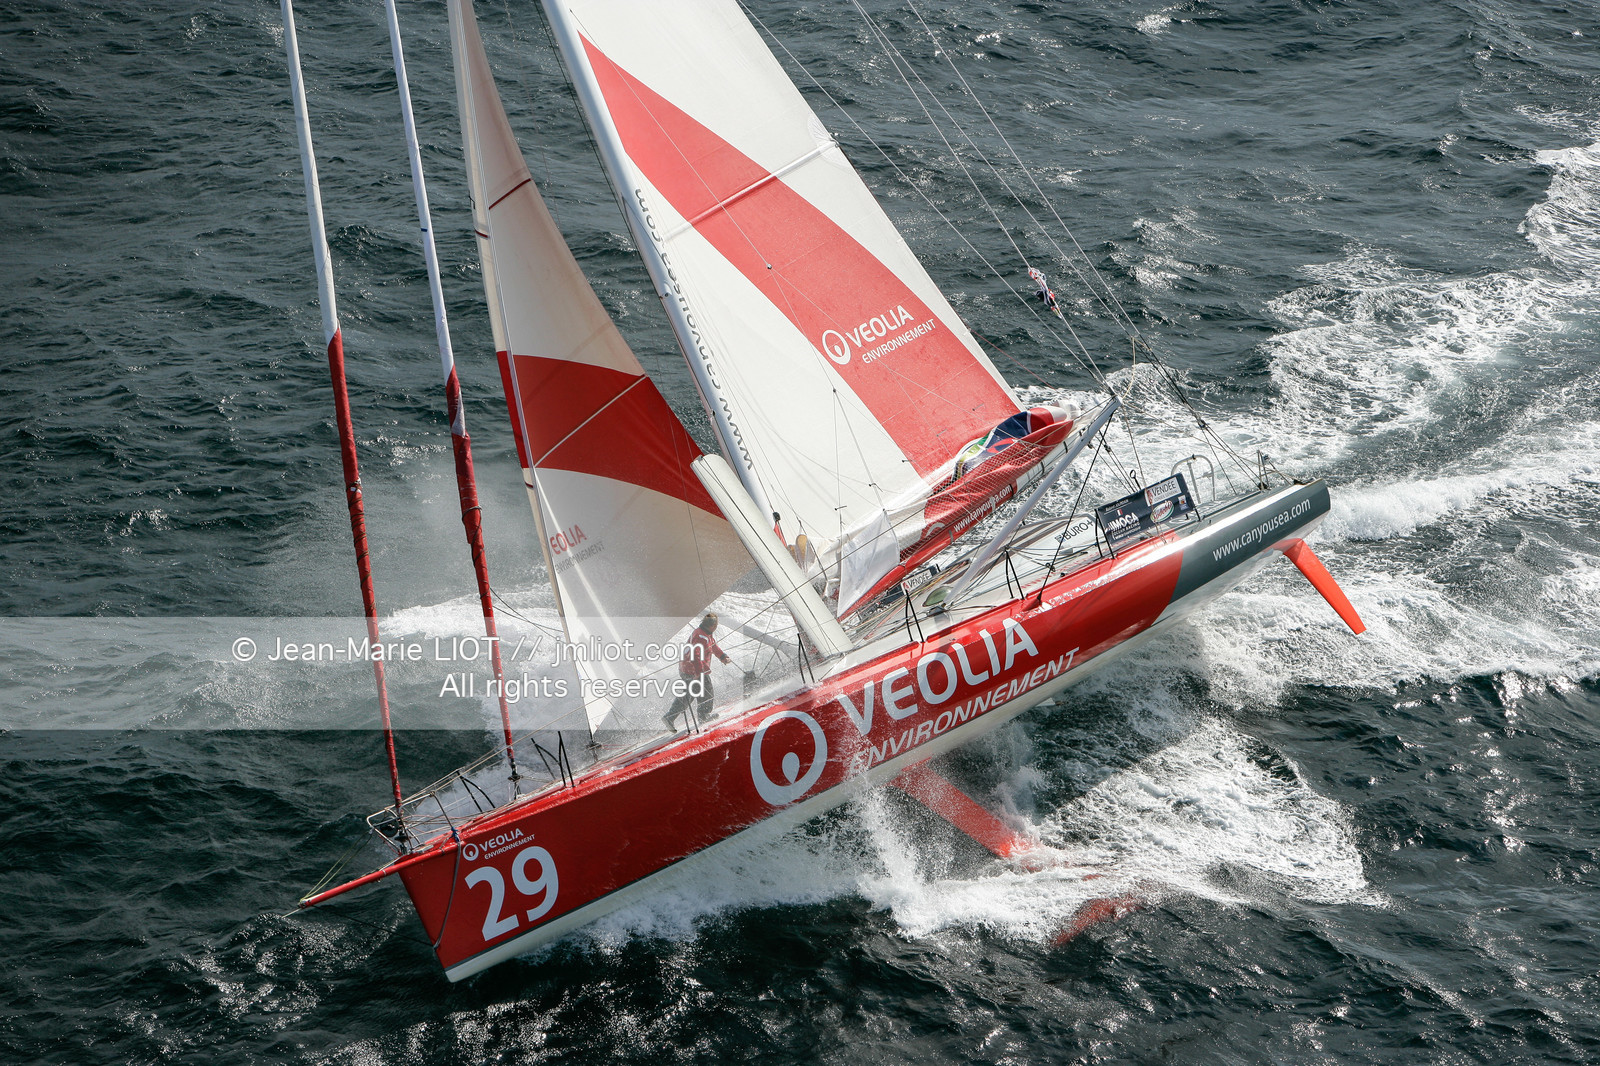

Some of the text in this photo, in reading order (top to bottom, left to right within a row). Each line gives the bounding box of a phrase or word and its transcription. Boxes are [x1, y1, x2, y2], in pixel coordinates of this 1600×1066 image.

[845, 305, 914, 348] VEOLIA
[862, 318, 936, 364] ENVIRONNEMENT
[953, 484, 1012, 533] www.canyoua.com
[1151, 480, 1177, 497] VENDÉE
[549, 524, 587, 557] EOLIA
[1212, 497, 1311, 562] www.canyousea.com
[835, 617, 1039, 737] VEOLIA
[849, 647, 1080, 775] ENVIRONNEMENT
[479, 828, 524, 852] VEOLIA
[484, 833, 535, 860] ENVIRONNEMENT
[464, 845, 559, 942] 29
